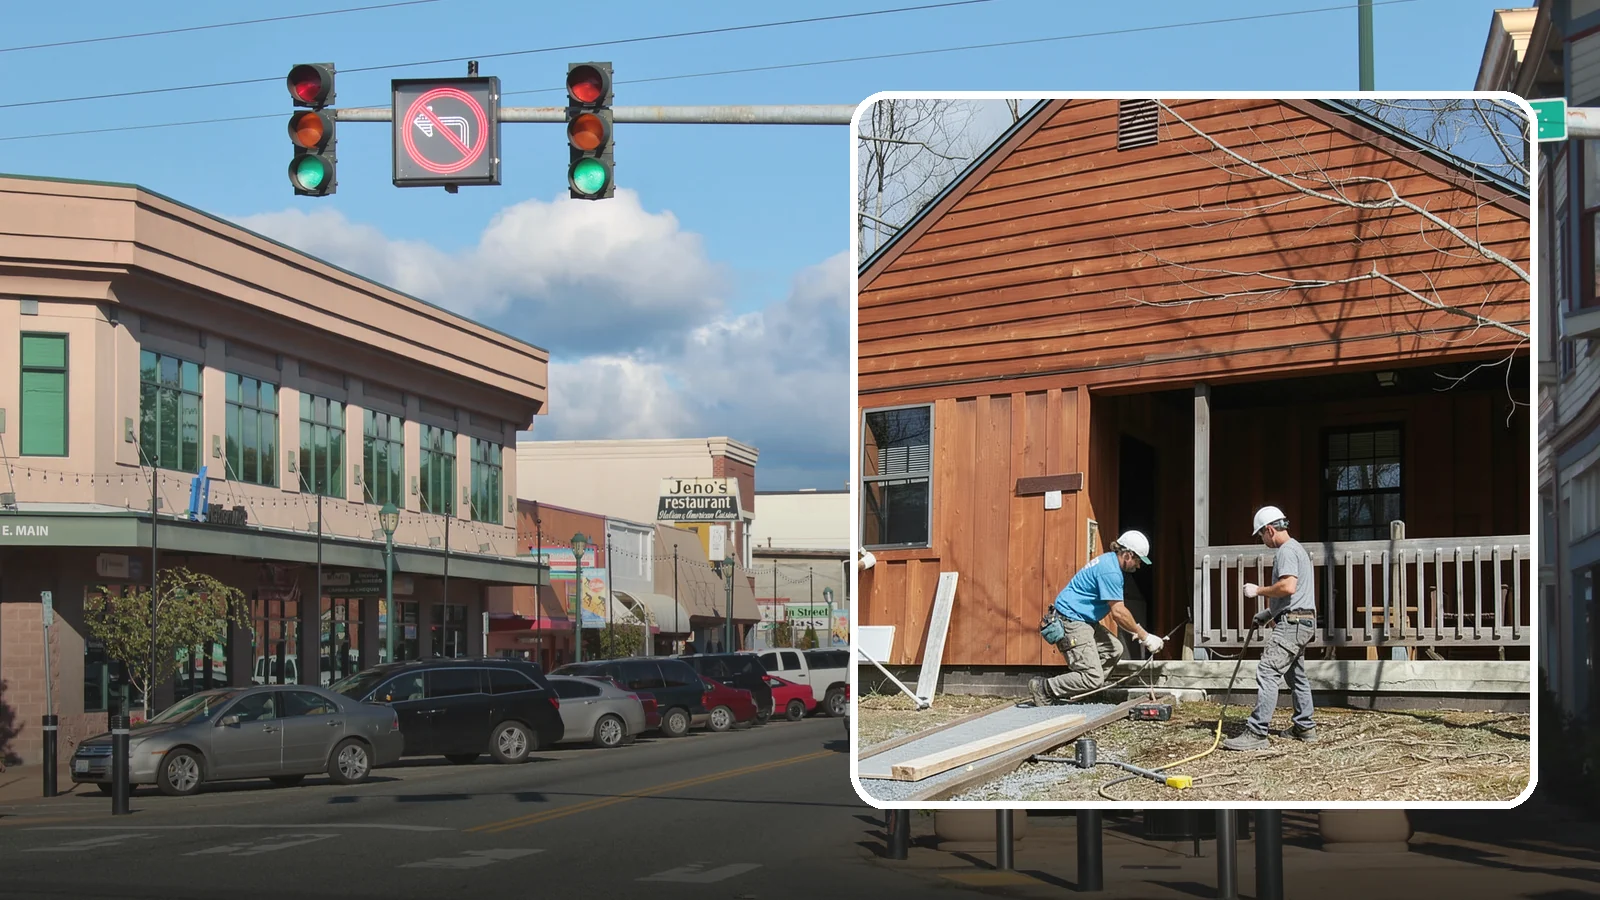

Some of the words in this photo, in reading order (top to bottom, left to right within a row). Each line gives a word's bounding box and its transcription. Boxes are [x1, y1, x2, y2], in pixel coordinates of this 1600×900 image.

[670, 480, 728, 495] Jeno's
[665, 496, 731, 509] restaurant
[658, 510, 681, 519] Italian
[686, 509, 714, 519] American
[715, 509, 737, 519] Cuisine
[2, 525, 13, 536] E.
[15, 525, 49, 536] MAIN
[797, 608, 828, 616] Street
[791, 619, 824, 627] lass
